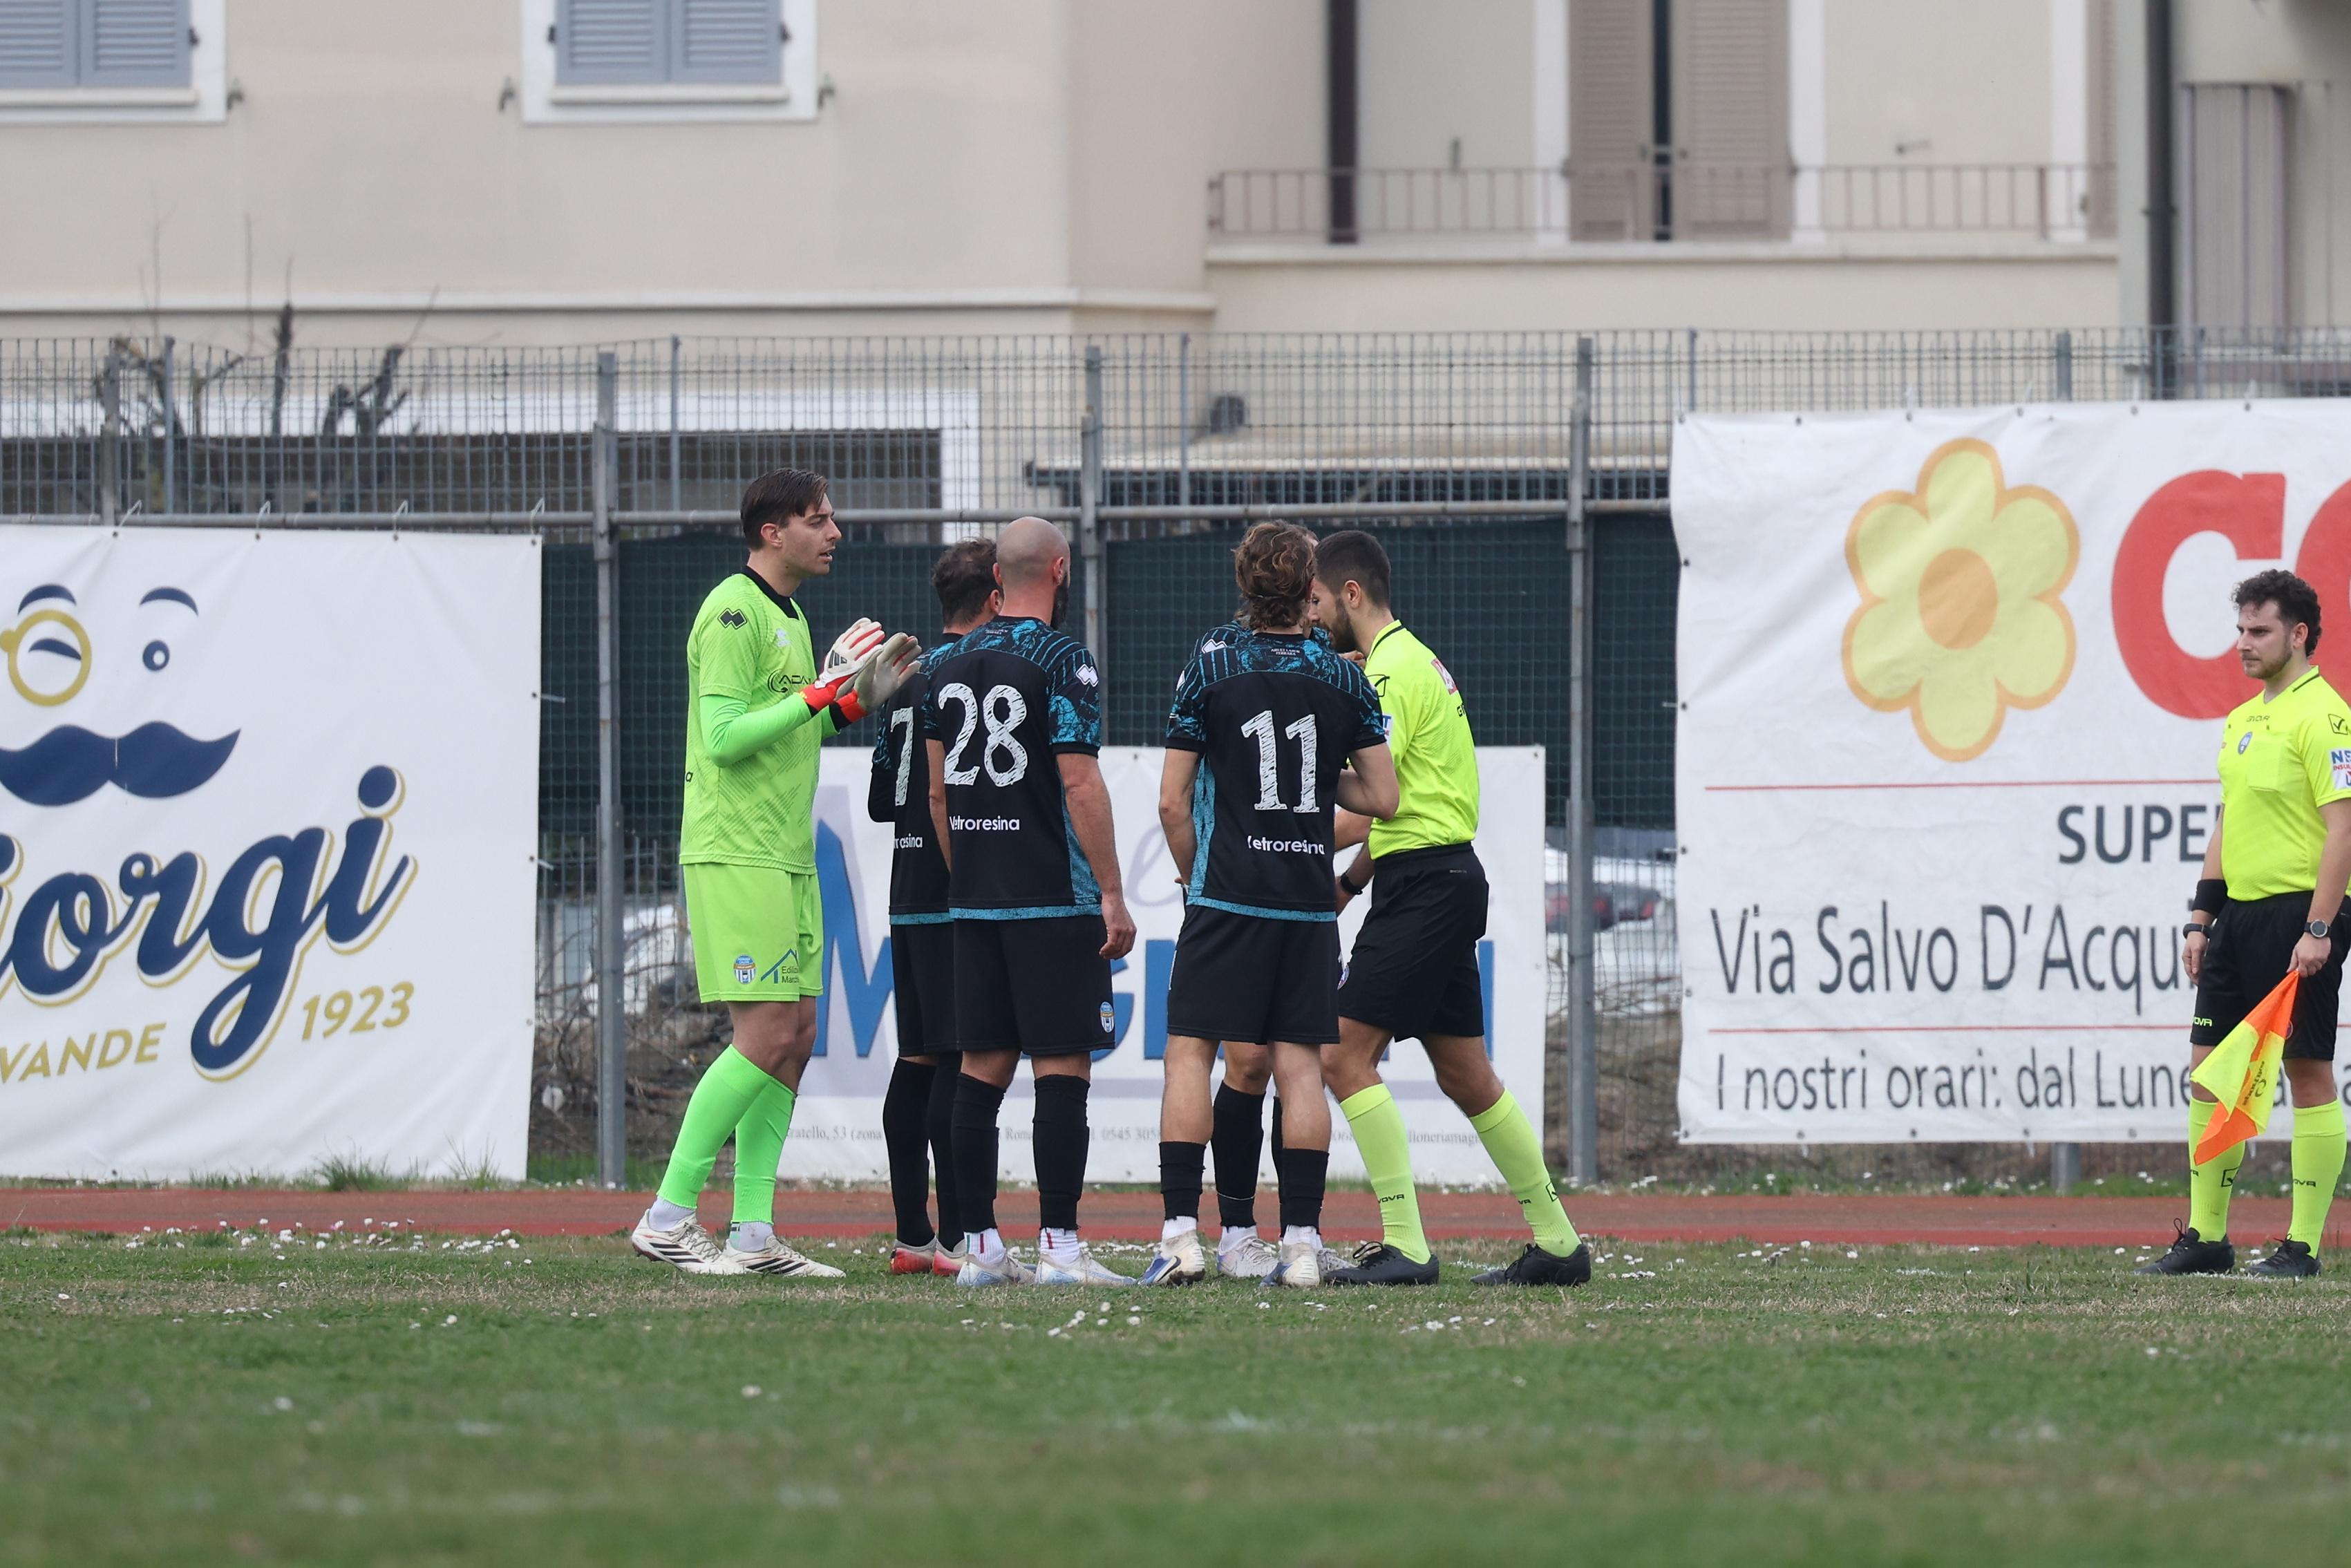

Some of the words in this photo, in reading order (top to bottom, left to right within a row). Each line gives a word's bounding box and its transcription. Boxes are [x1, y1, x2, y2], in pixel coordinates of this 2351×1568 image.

[891, 706, 914, 806] 7
[938, 682, 1028, 788] 28
[1241, 709, 1320, 813] 11
[2057, 804, 2220, 863] SUPE
[1710, 904, 1795, 994] Via
[1817, 900, 1959, 994] Salvo
[0, 1021, 167, 1084] VANDE
[302, 981, 415, 1042] 1923
[1717, 1053, 1724, 1111] I
[1743, 1048, 1866, 1111] nostri
[1887, 1048, 2001, 1109] orari:
[2017, 1047, 2074, 1108] dal
